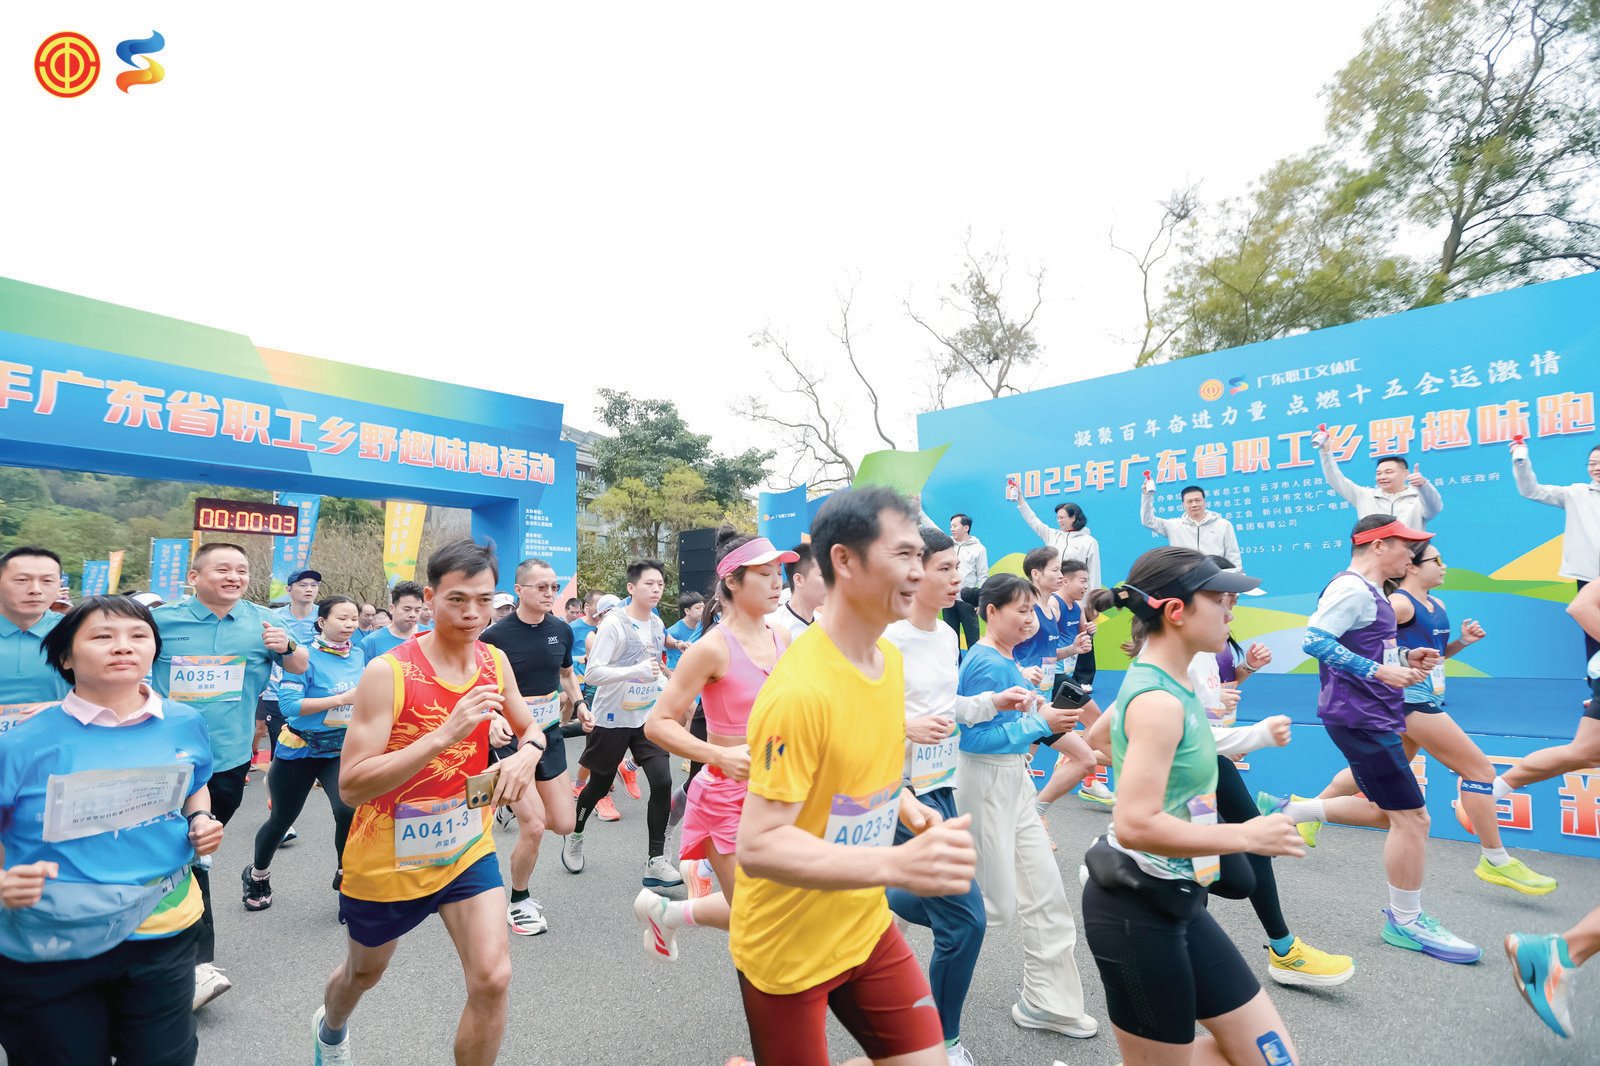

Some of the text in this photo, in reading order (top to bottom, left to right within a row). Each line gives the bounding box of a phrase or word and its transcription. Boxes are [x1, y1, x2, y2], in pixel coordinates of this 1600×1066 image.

[1257, 356, 1361, 389] 广东职工文体汇
[1073, 349, 1562, 448] 凝聚百年奋进力量 点燃十五全运激情
[0, 360, 555, 484] 年广东省职工乡野趣味跑活动
[1260, 477, 1329, 492] 云浮市人民政
[1261, 489, 1337, 503] 云浮市文化广电
[1434, 472, 1500, 487] 县人民政府
[199, 508, 295, 535] 00:00:03
[1262, 501, 1354, 516] 新兴县文化广电旅
[1236, 519, 1298, 532] 集团有限公司
[174, 670, 230, 682] A035-1
[533, 704, 554, 718] 57-2
[916, 743, 953, 762] A017-3
[402, 810, 469, 841] A041-3
[833, 809, 894, 845] A023-3
